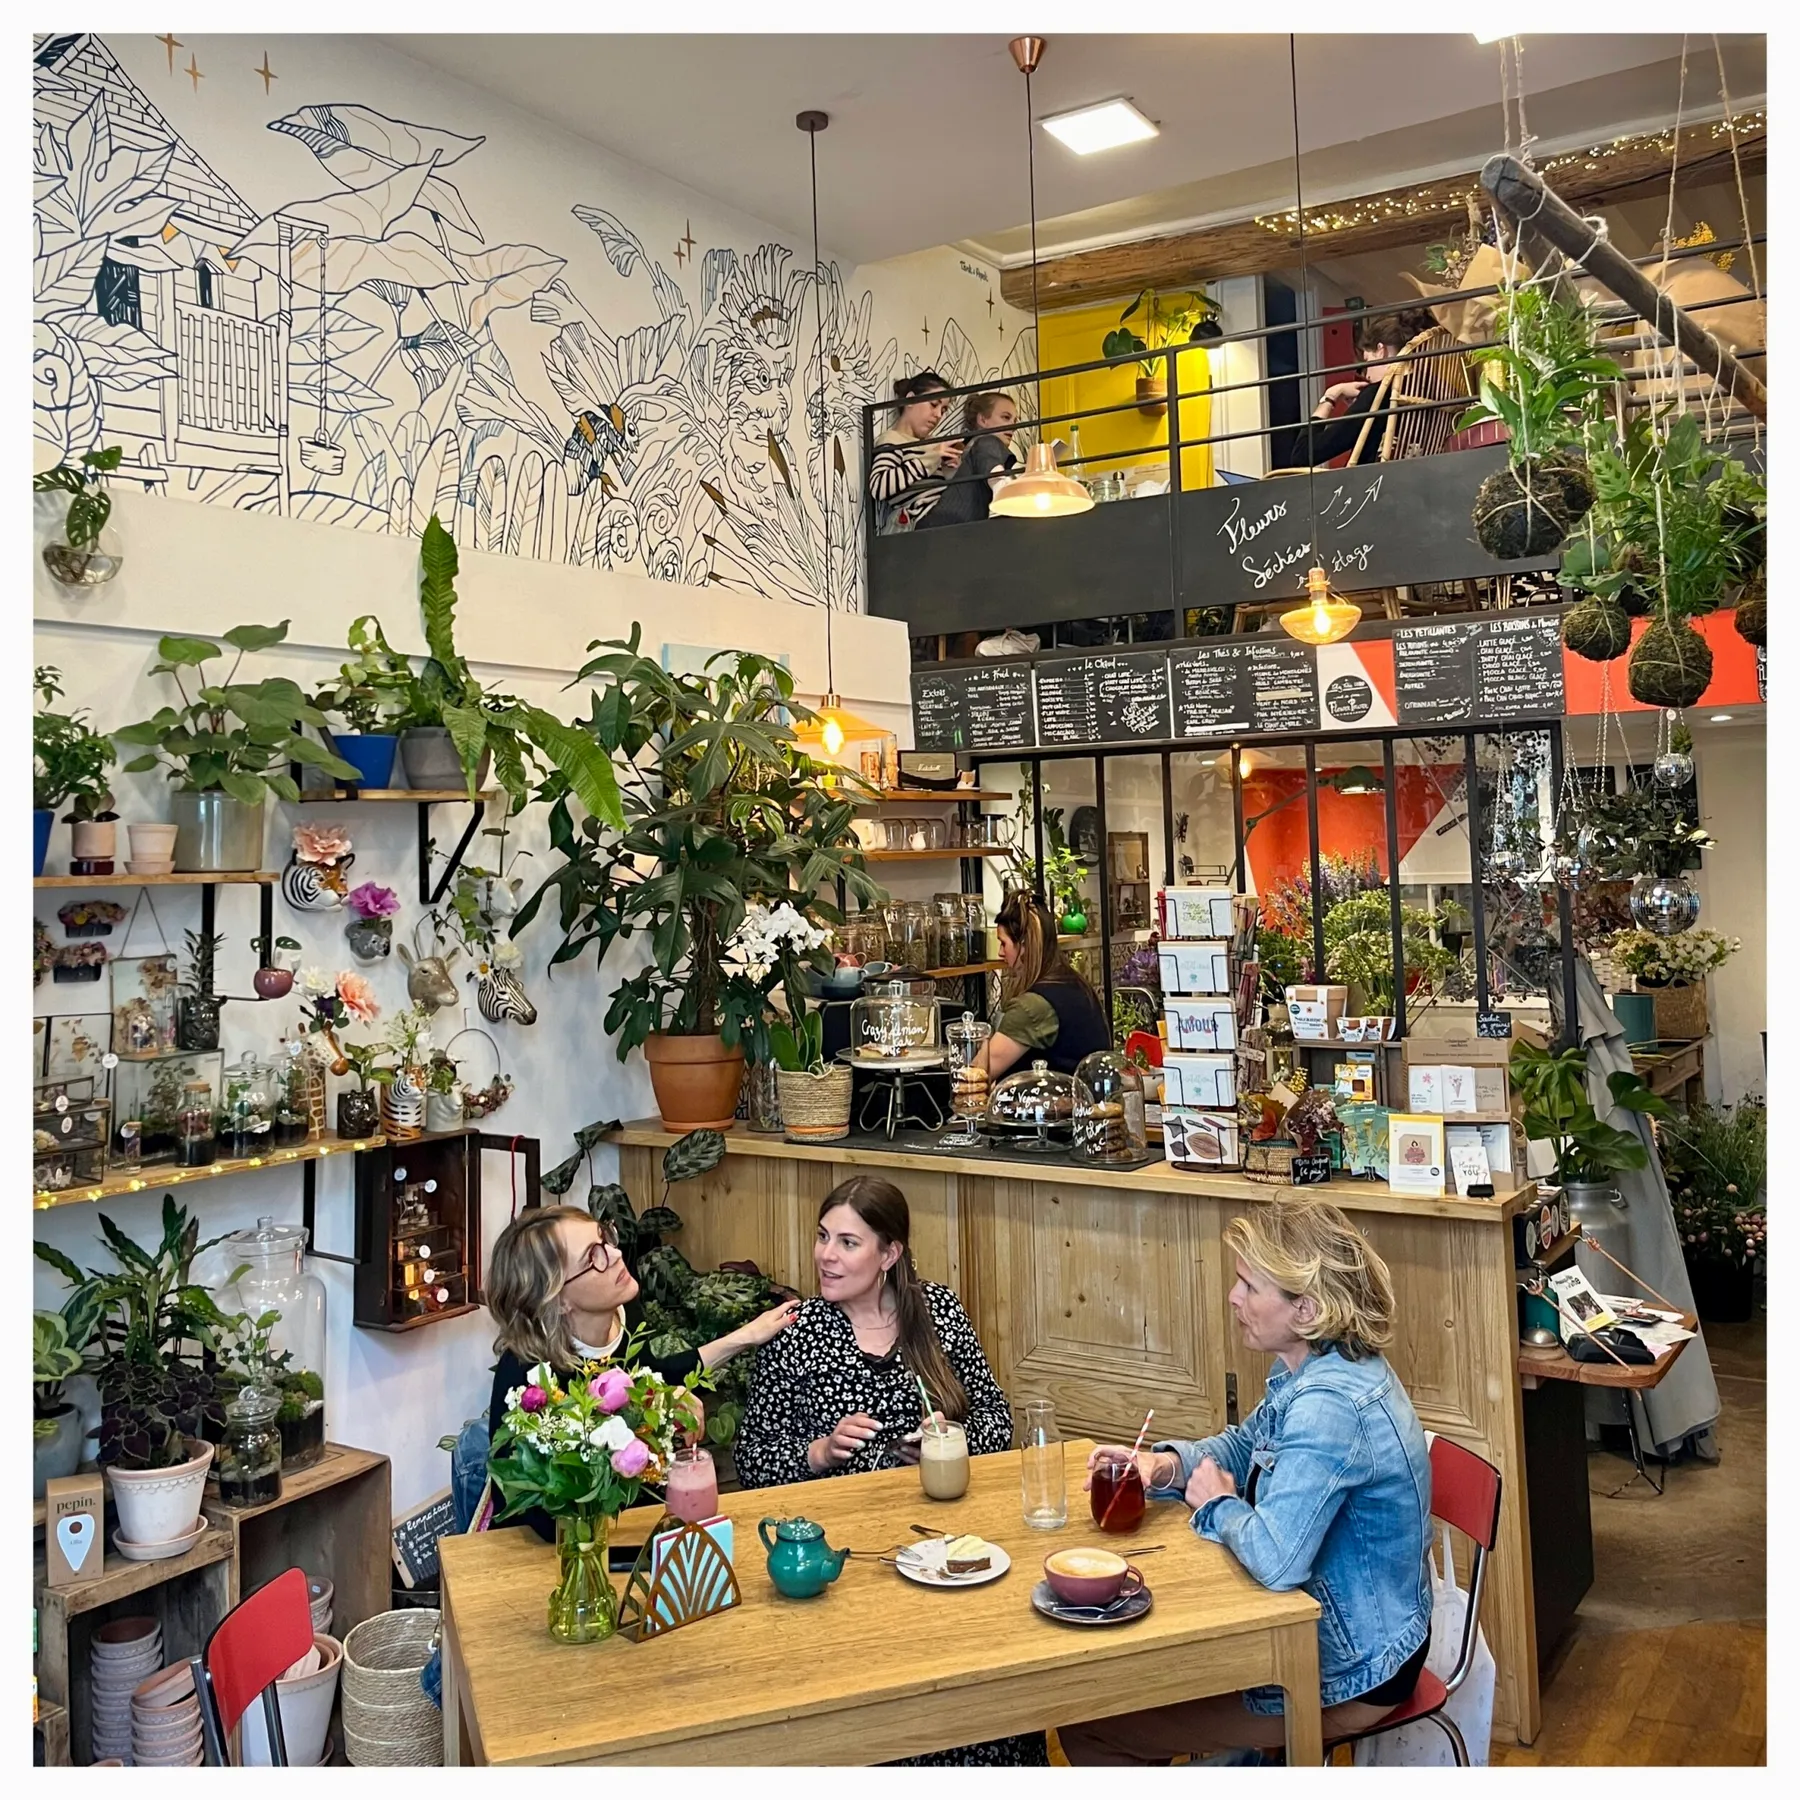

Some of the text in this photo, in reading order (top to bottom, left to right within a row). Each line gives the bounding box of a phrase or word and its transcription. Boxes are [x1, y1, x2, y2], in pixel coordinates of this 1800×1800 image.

[1216, 497, 1287, 555] Fleurs
[1241, 542, 1312, 589] Séchées
[1400, 628, 1413, 638] LES
[1490, 621, 1502, 633] LES
[1479, 638, 1498, 647] LATTE
[1198, 650, 1210, 660] Les
[1212, 648, 1230, 659] Thés
[1245, 645, 1277, 657] Infusions
[1084, 656, 1116, 670] Le Chaud
[981, 670, 990, 679] Le
[861, 1019, 888, 1043] Crazy
[1177, 1017, 1219, 1033] AMOUR
[56, 1496, 96, 1514] pepin.
